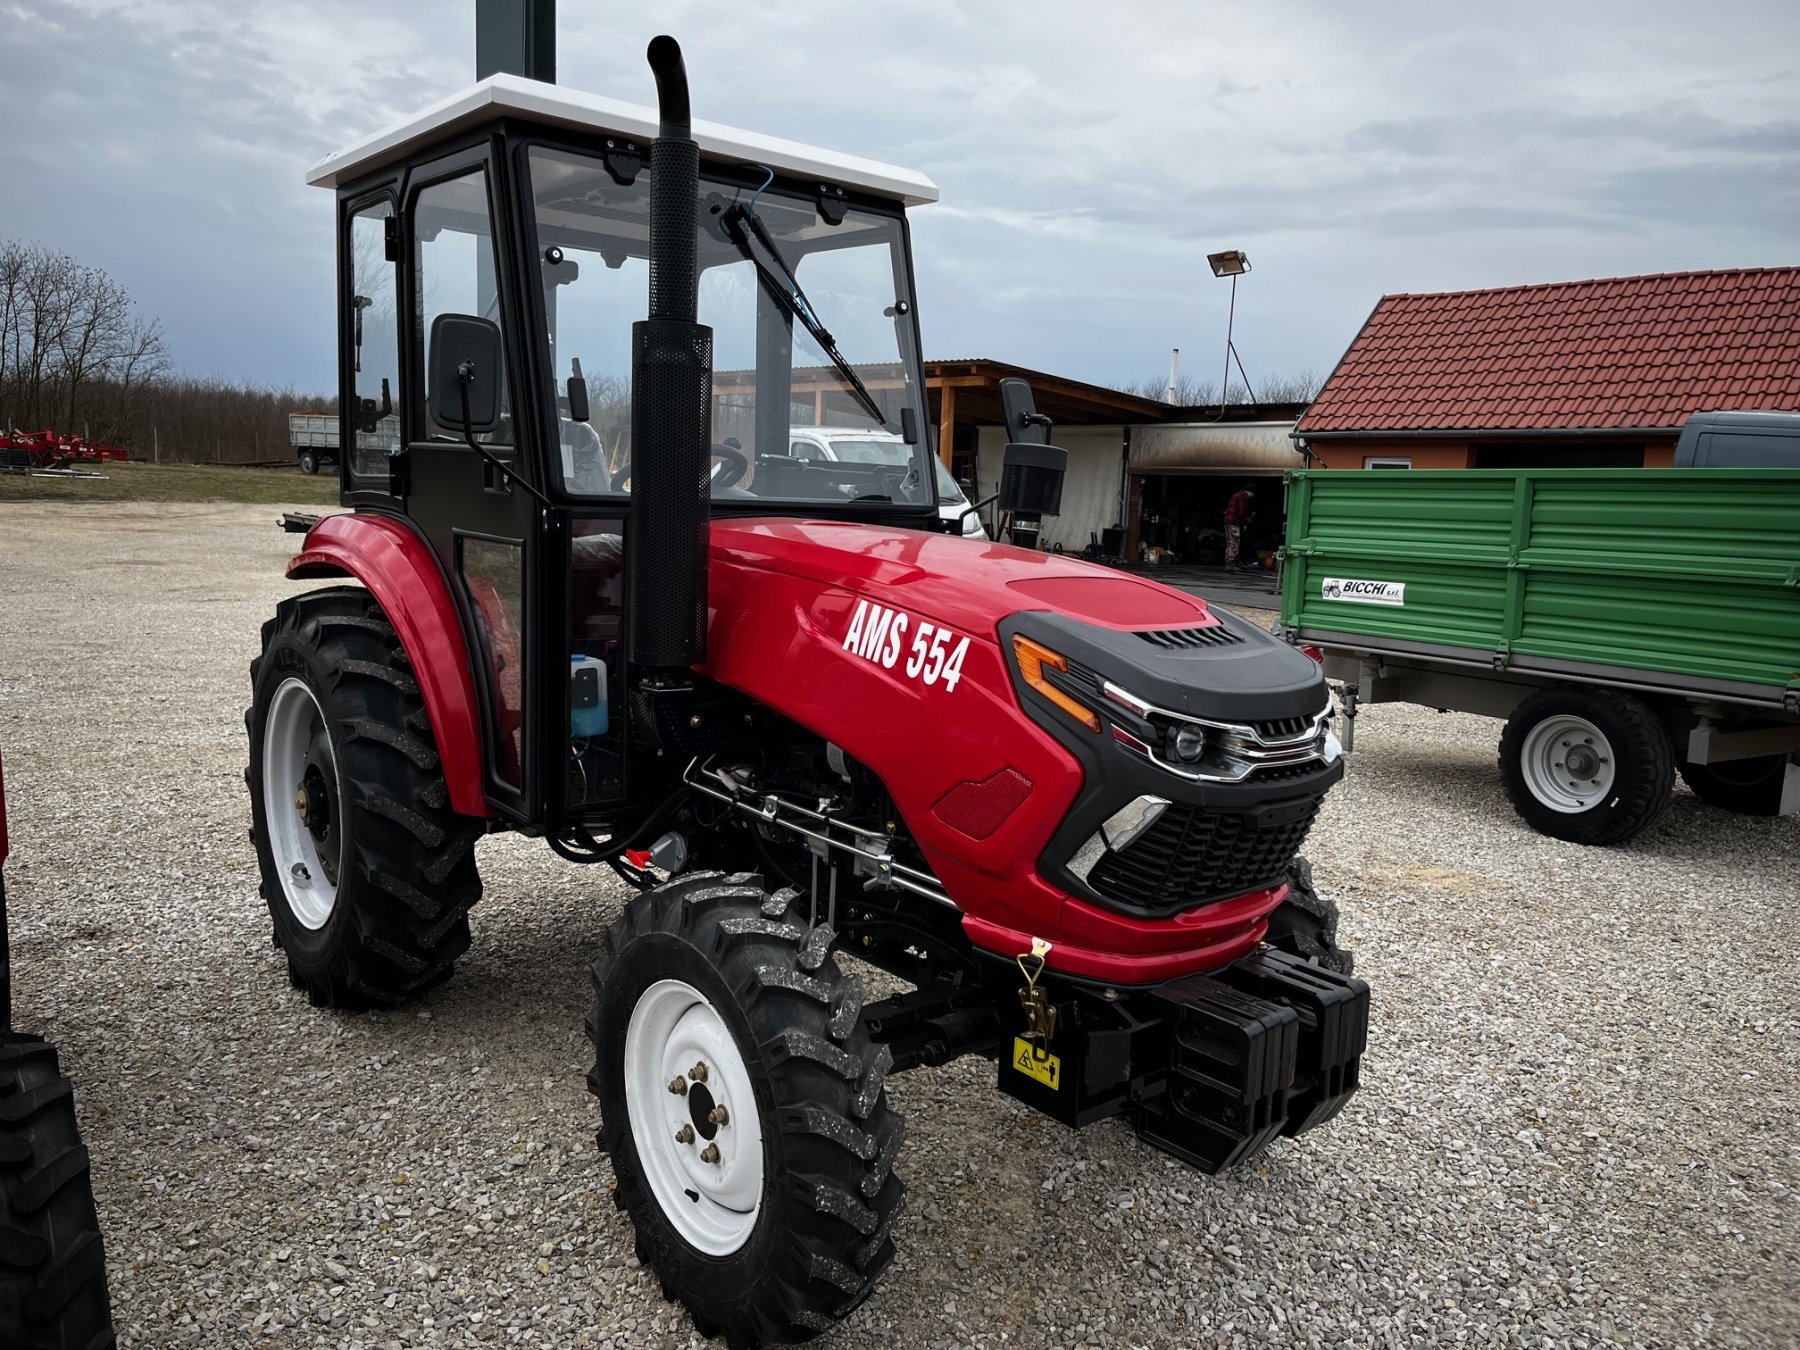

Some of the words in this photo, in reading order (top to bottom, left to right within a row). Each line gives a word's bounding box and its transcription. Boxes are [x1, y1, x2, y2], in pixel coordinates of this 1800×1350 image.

[1343, 581, 1388, 595] BICCHI
[842, 599, 909, 669] AMS
[906, 621, 971, 693] 554
